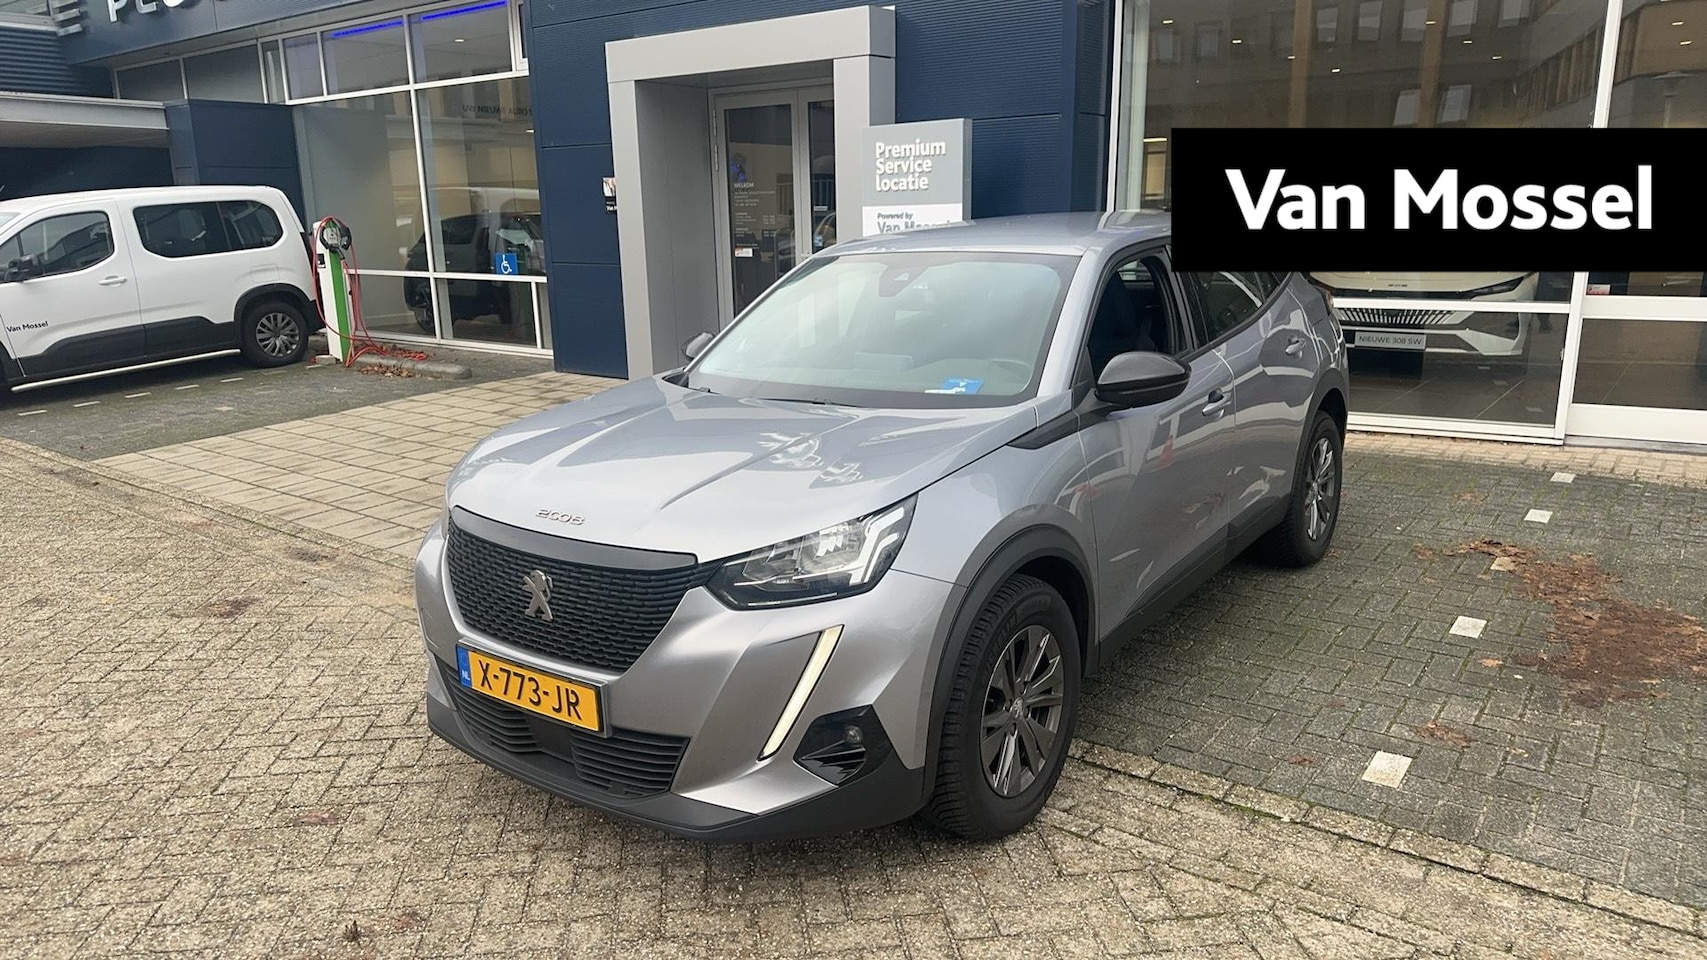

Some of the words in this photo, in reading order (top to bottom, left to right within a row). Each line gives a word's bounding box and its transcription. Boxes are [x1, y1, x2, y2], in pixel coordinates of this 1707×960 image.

[875, 139, 946, 158] Premium
[875, 157, 932, 175] Service
[875, 173, 929, 192] locatie
[877, 212, 904, 220] Powered
[905, 212, 913, 220] by
[877, 221, 900, 234] Van
[22, 320, 48, 330] Mossel
[535, 509, 585, 525] 2008
[461, 669, 470, 680] NL
[478, 659, 582, 720] X-773-JR
